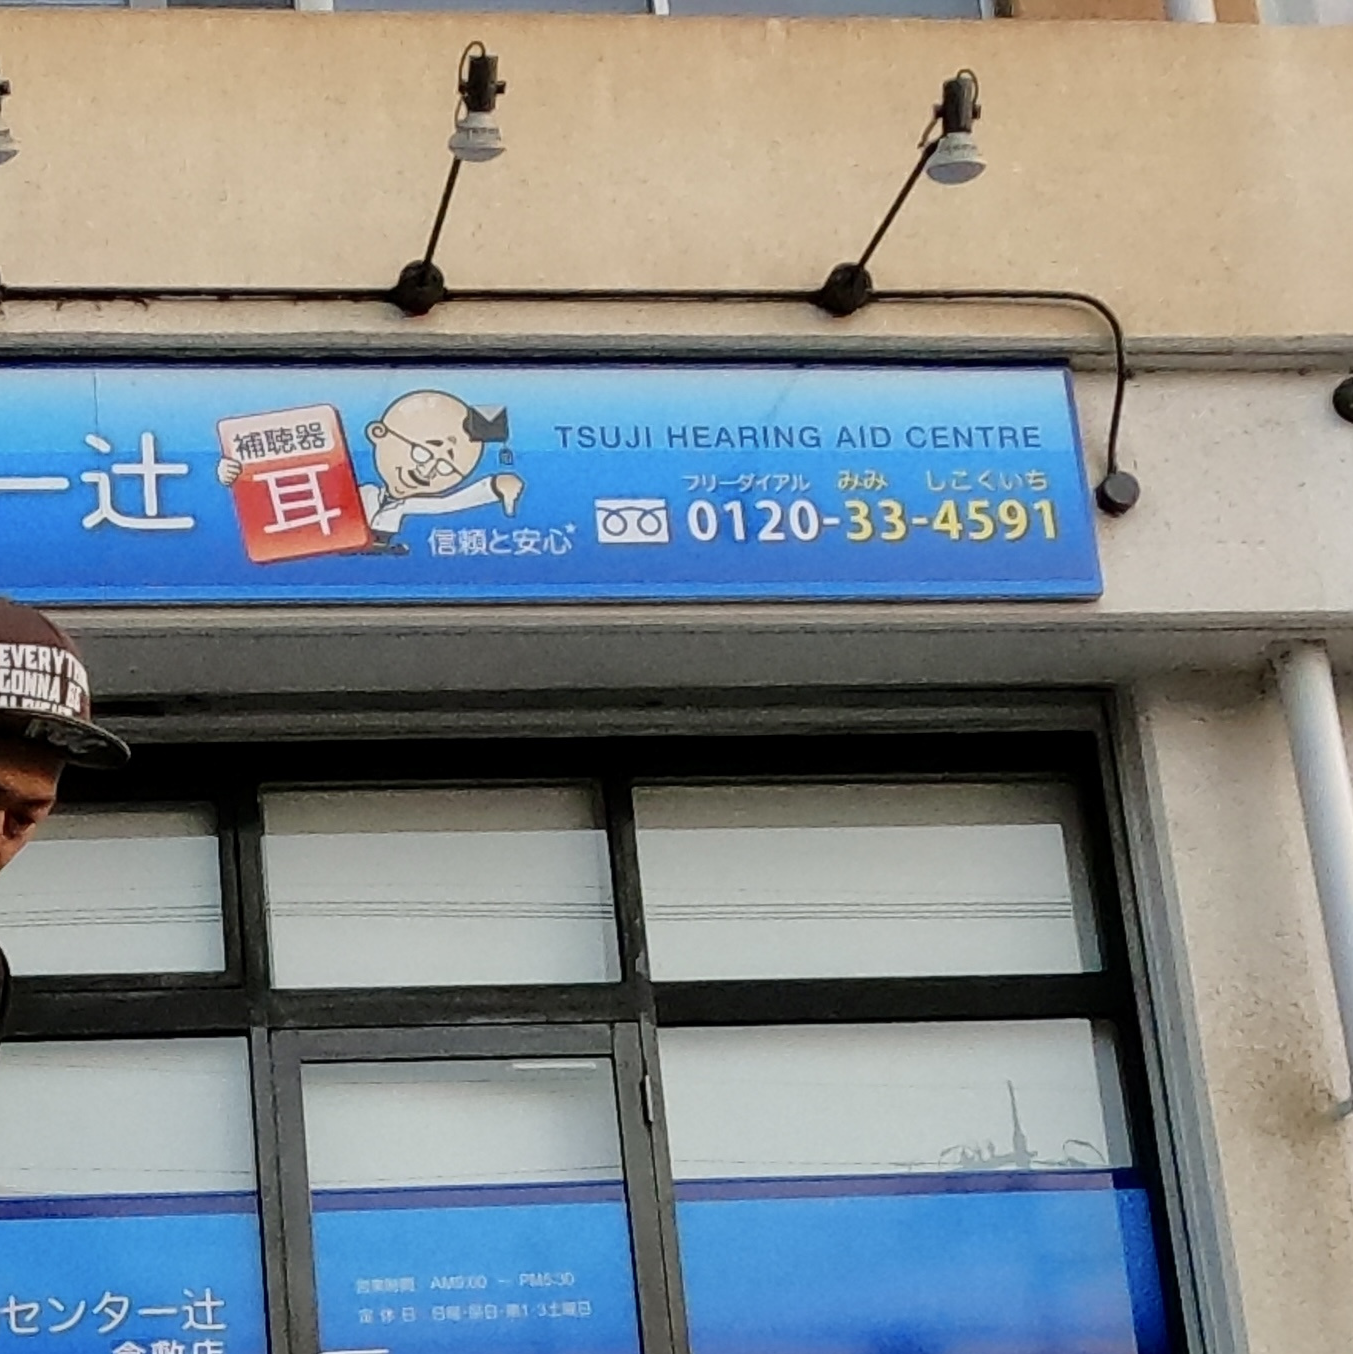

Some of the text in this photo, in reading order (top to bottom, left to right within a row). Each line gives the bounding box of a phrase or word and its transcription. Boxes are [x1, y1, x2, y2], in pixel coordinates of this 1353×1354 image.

[233, 421, 327, 459] 補聴器
[554, 425, 1042, 449] TSUJI HEARING AID CENTRE
[252, 463, 342, 536] 耳
[681, 474, 811, 493] フリーダイアル
[836, 470, 889, 492] みみ
[687, 499, 1058, 542] 0120-33-4591
